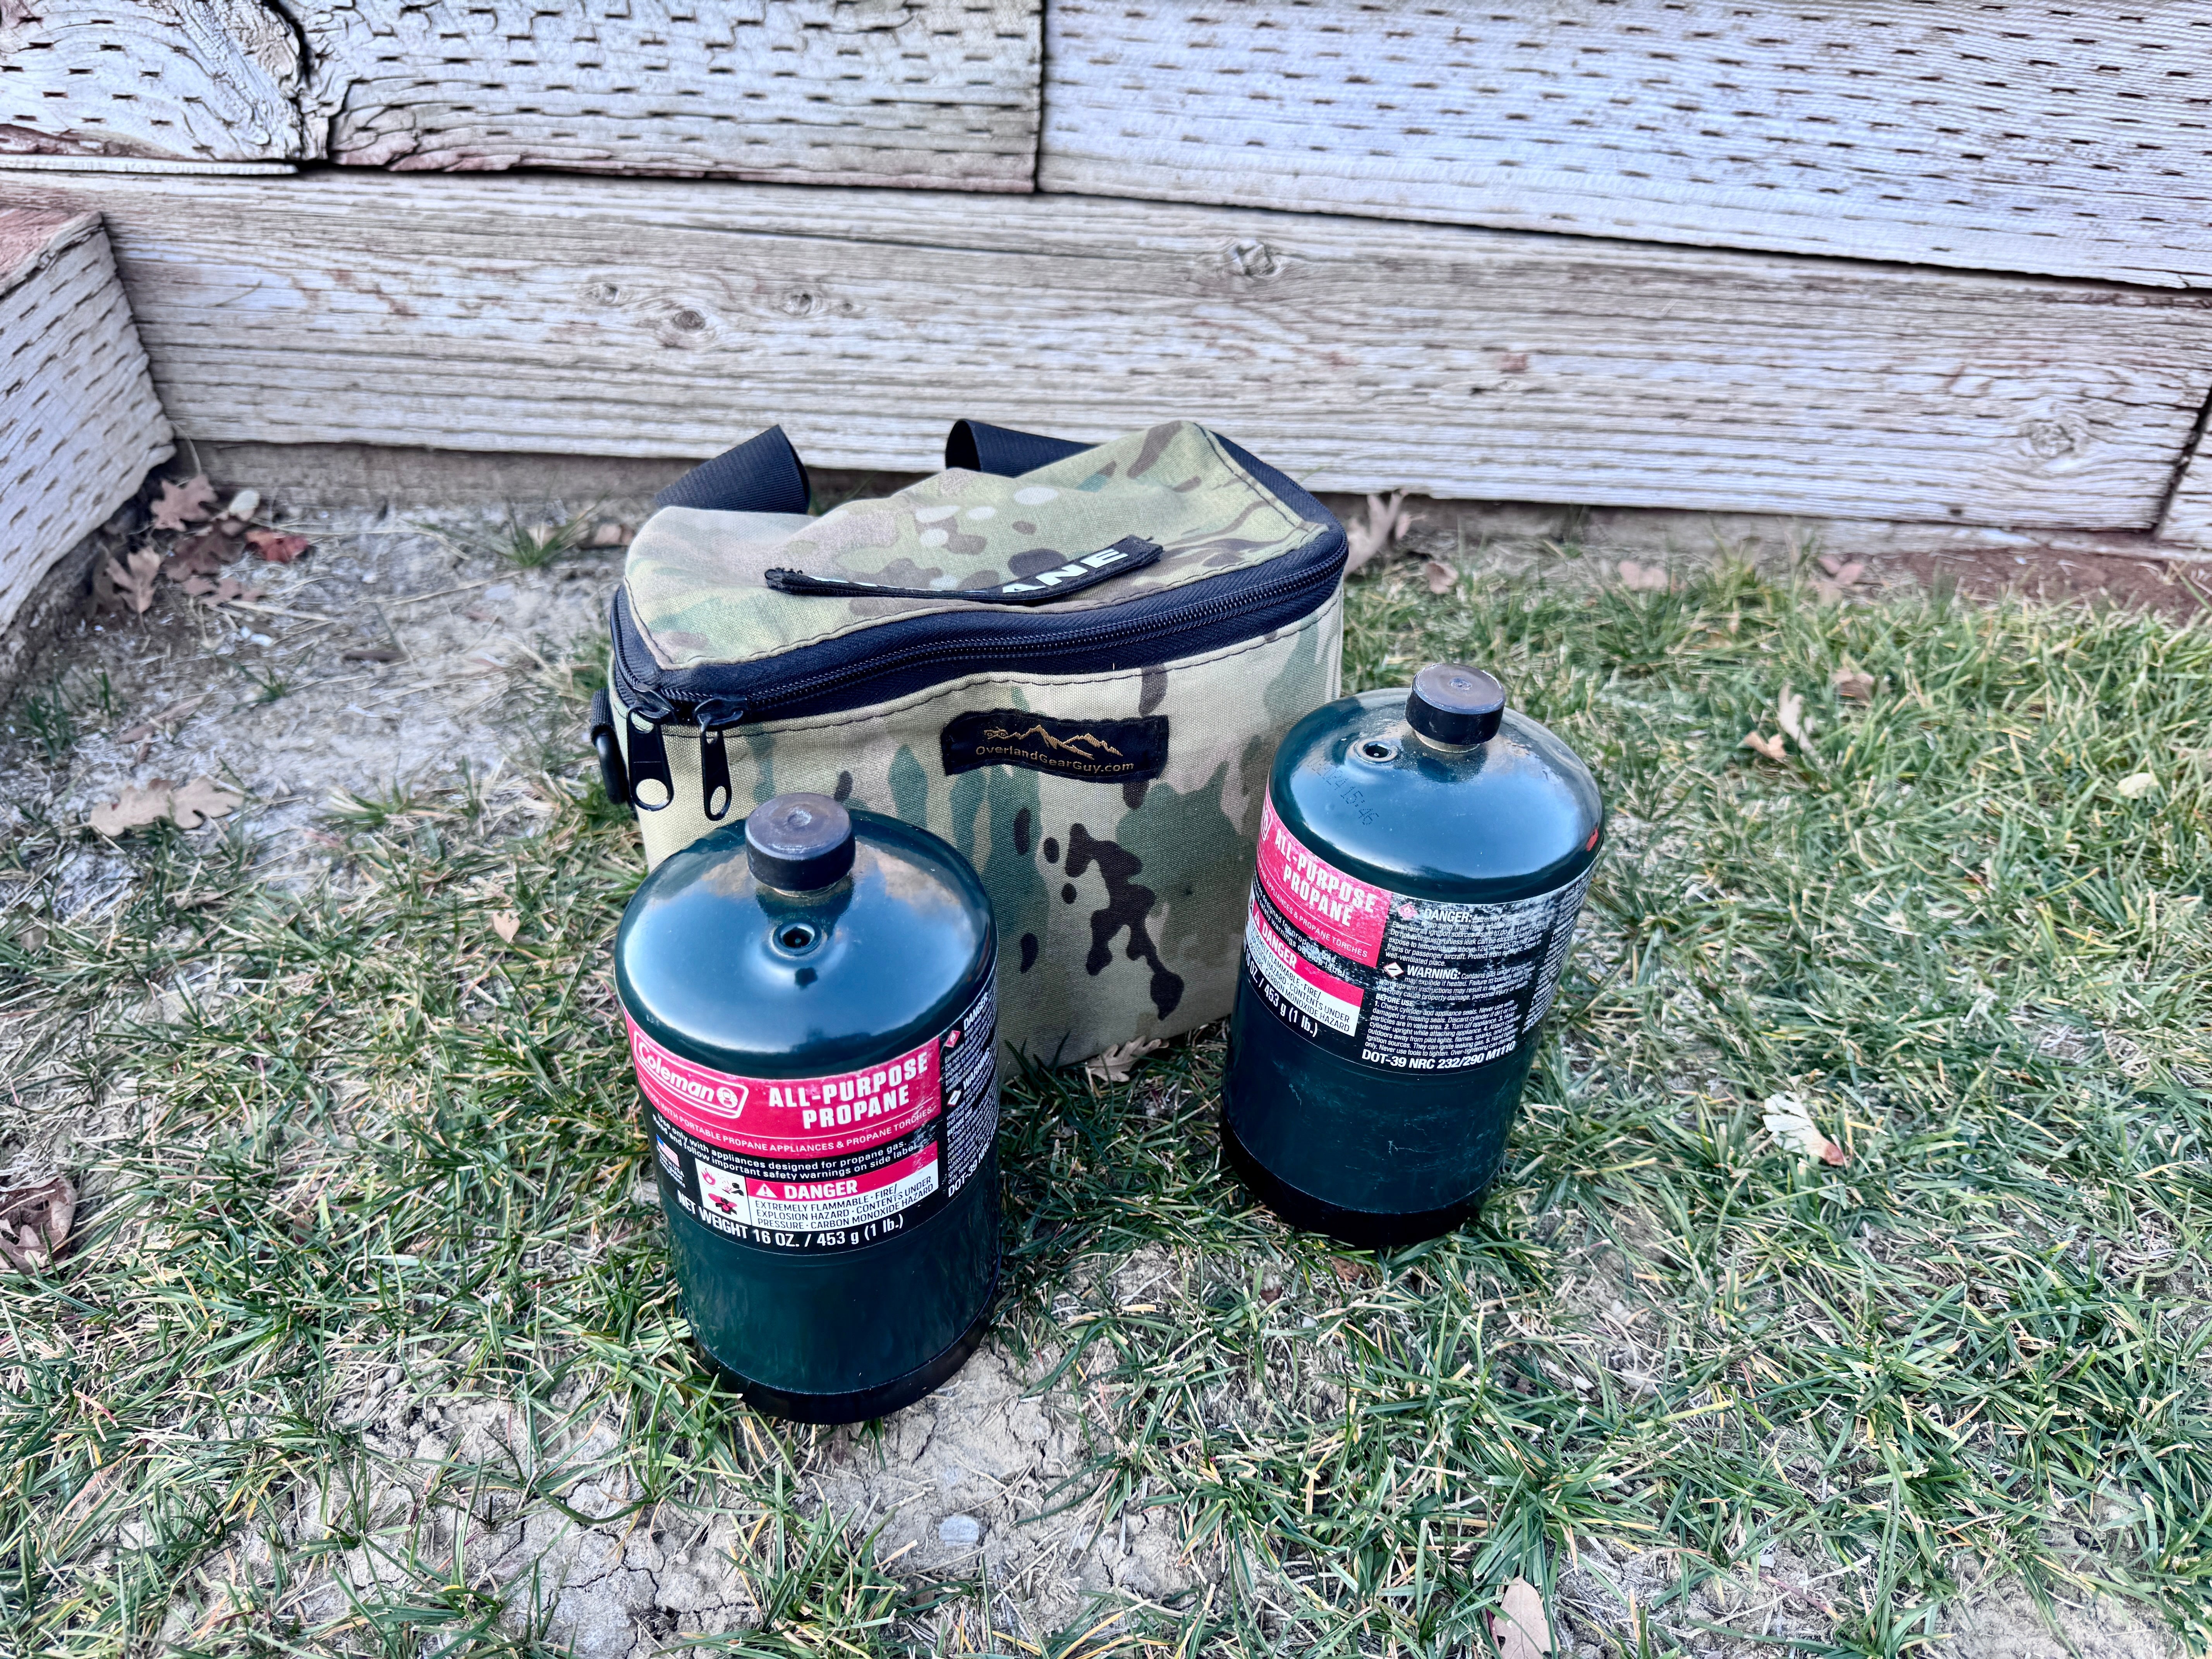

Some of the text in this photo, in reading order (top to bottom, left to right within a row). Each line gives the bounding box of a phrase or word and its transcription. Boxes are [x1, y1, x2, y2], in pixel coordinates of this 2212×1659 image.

[976, 745, 1134, 774] OverlandGearGuy.com
[1340, 786, 1379, 825] 15:46
[1275, 828, 1377, 913] ALL-PURPOSE
[1283, 863, 1354, 927] PROPANE
[1266, 879, 1293, 914] APPLIANCES
[1299, 915, 1331, 941] PROPANE
[1332, 936, 1368, 958] TORCHES
[1424, 908, 1472, 923] DANGER:
[1262, 921, 1297, 970] DANGER
[1271, 918, 1297, 947] warnings
[1389, 937, 1410, 947] expose
[1418, 942, 1457, 953] temperatures
[1385, 951, 1428, 965] well-ventilated
[1387, 943, 1403, 953] trains
[1412, 949, 1444, 960] passenger
[1269, 952, 1321, 1000] FLAMMABLE FIRE/
[1407, 965, 1461, 980] WARNING:
[1265, 969, 1350, 1032] CARBON MONOXIDE HAZARD
[1267, 960, 1350, 1023] HAZARD CONTENTS UNDER
[1376, 993, 1400, 1005] BEFORE
[1421, 994, 1446, 1002] property
[1472, 990, 1495, 1001] personal
[1264, 984, 1279, 1007] 453
[1280, 1003, 1286, 1017] g
[1288, 1007, 1298, 1023] (1
[1301, 1015, 1318, 1038] lb.)
[1370, 1014, 1396, 1025] particles
[1372, 1007, 1399, 1018] damaged
[1407, 1015, 1429, 1024] missing
[1381, 1002, 1398, 1012] Check
[1399, 1007, 1422, 1015] cylinder
[1366, 1034, 1387, 1044] ignition
[1388, 1040, 1412, 1048] sources.
[1413, 1042, 1427, 1051] They
[1439, 1043, 1454, 1051] ignite
[1368, 1028, 1393, 1039] outdoors
[1393, 1034, 1409, 1042] away
[1369, 1021, 1392, 1031] cylinder
[1392, 1027, 1413, 1036] upright
[1429, 1029, 1456, 1037] attaching
[1362, 1048, 1407, 1068] DOT-39
[1408, 1057, 1436, 1069] NRC
[1437, 1053, 1485, 1069] 232/290
[1486, 1041, 1517, 1061] M1110
[1365, 1041, 1377, 1050] only.
[1379, 1044, 1396, 1053] Never
[638, 1042, 714, 1103] Coleman
[769, 1052, 928, 1108] ALL-PURPOSE
[802, 1084, 910, 1129] PROPANE
[658, 1113, 907, 1171] Use only with appliances designed for propane gas.
[661, 1104, 932, 1153] WITH PORTABLE PROPANE APPLIANCES & PROPANE TORCHES
[669, 1133, 683, 1147] and
[684, 1143, 710, 1161] follow
[712, 1158, 761, 1177] important
[763, 1170, 797, 1181] safety
[800, 1167, 851, 1179] warnings
[854, 1164, 867, 1172] on
[870, 1156, 891, 1168] side
[784, 1180, 858, 1199] DANGER
[948, 1159, 977, 1197] DOT-39
[755, 1183, 897, 1212] EXTREMELY FLAMMABLE FIRE/
[756, 1176, 931, 1221] EXPLOSION HAZARD CONTENTS UNDER
[757, 1183, 934, 1230] PRESSURE CARBON MONOXIDE HAZARD
[677, 1189, 904, 1247] NET WEIGHT 16 OZ. / 453 g (1 lb.)
